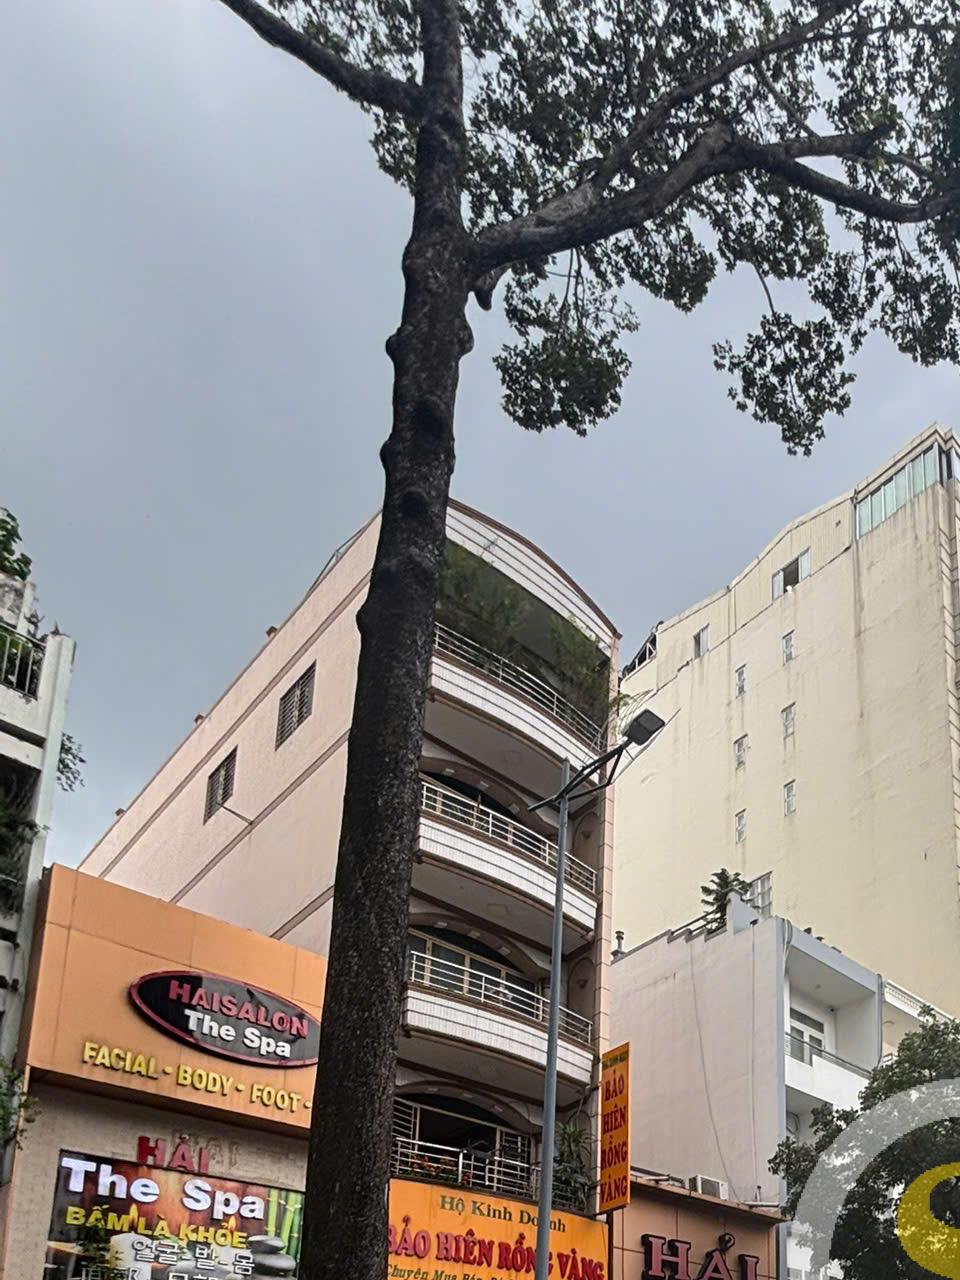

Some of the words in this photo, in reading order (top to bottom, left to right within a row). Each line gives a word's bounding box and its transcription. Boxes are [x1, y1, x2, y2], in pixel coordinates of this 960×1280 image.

[168, 979, 309, 1038] HAISALON
[184, 1008, 236, 1041] The
[243, 1027, 291, 1058] Spa
[82, 1041, 159, 1079] FACIAL
[176, 1064, 234, 1096] BODY
[250, 1083, 302, 1114] FOOT
[603, 1105, 627, 1135] HIÊN
[137, 1134, 210, 1174] HẢI
[61, 1156, 160, 1203] The
[182, 1178, 265, 1220] Spa
[137, 1214, 175, 1238] LÀ
[179, 1221, 248, 1249] KHỎE
[439, 1194, 465, 1216] Hộ
[471, 1200, 513, 1222] Kinh
[518, 1209, 566, 1233] Donh
[435, 1228, 495, 1271] HIÊN
